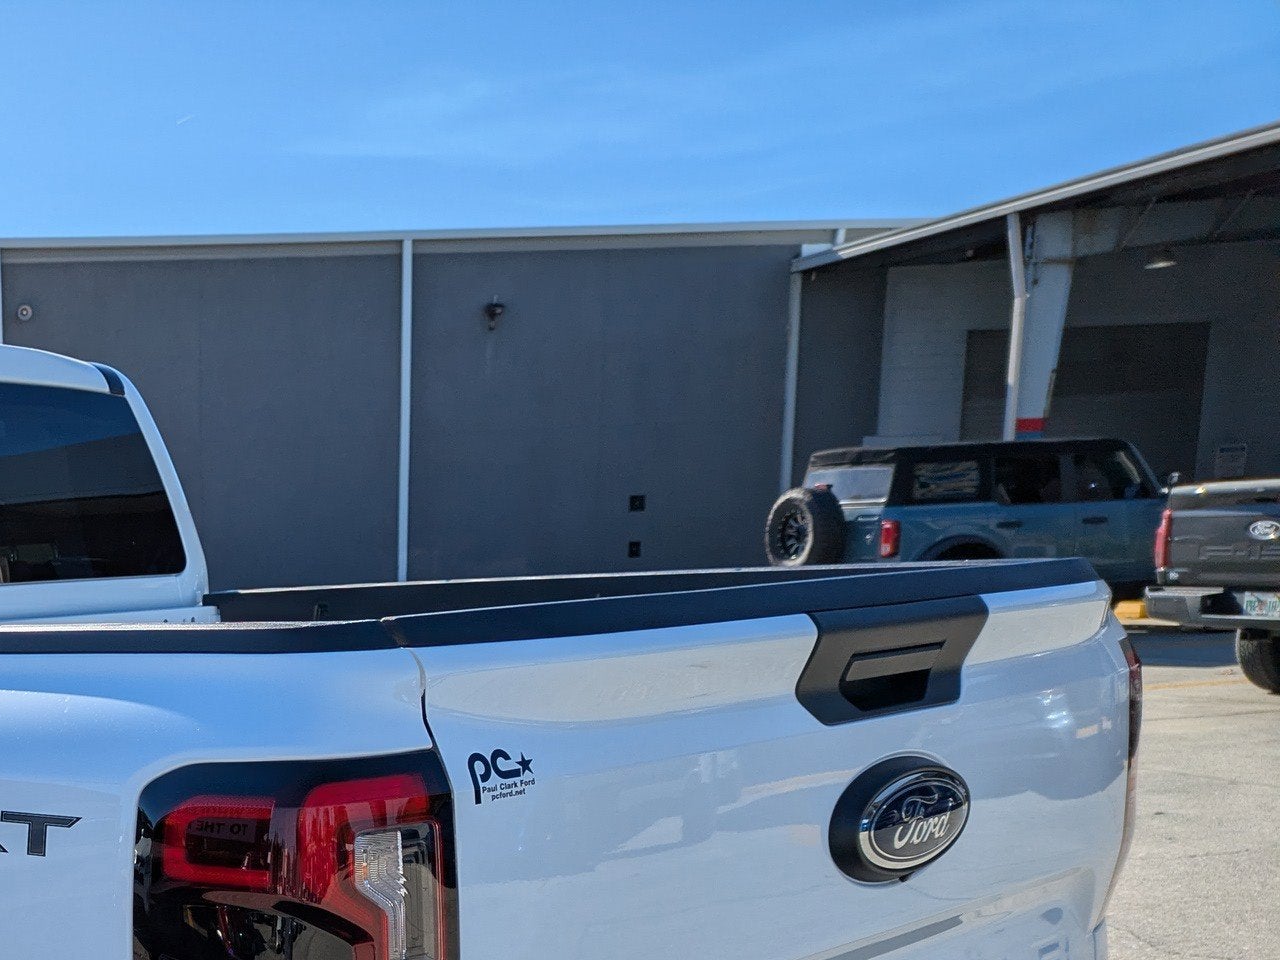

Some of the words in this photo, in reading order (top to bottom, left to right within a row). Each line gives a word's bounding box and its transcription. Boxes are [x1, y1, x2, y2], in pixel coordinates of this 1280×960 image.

[482, 784, 498, 794] Paul
[500, 781, 518, 791] Clark
[520, 778, 536, 788] Ford
[491, 788, 526, 801] pcford.net
[894, 792, 954, 850] Ford
